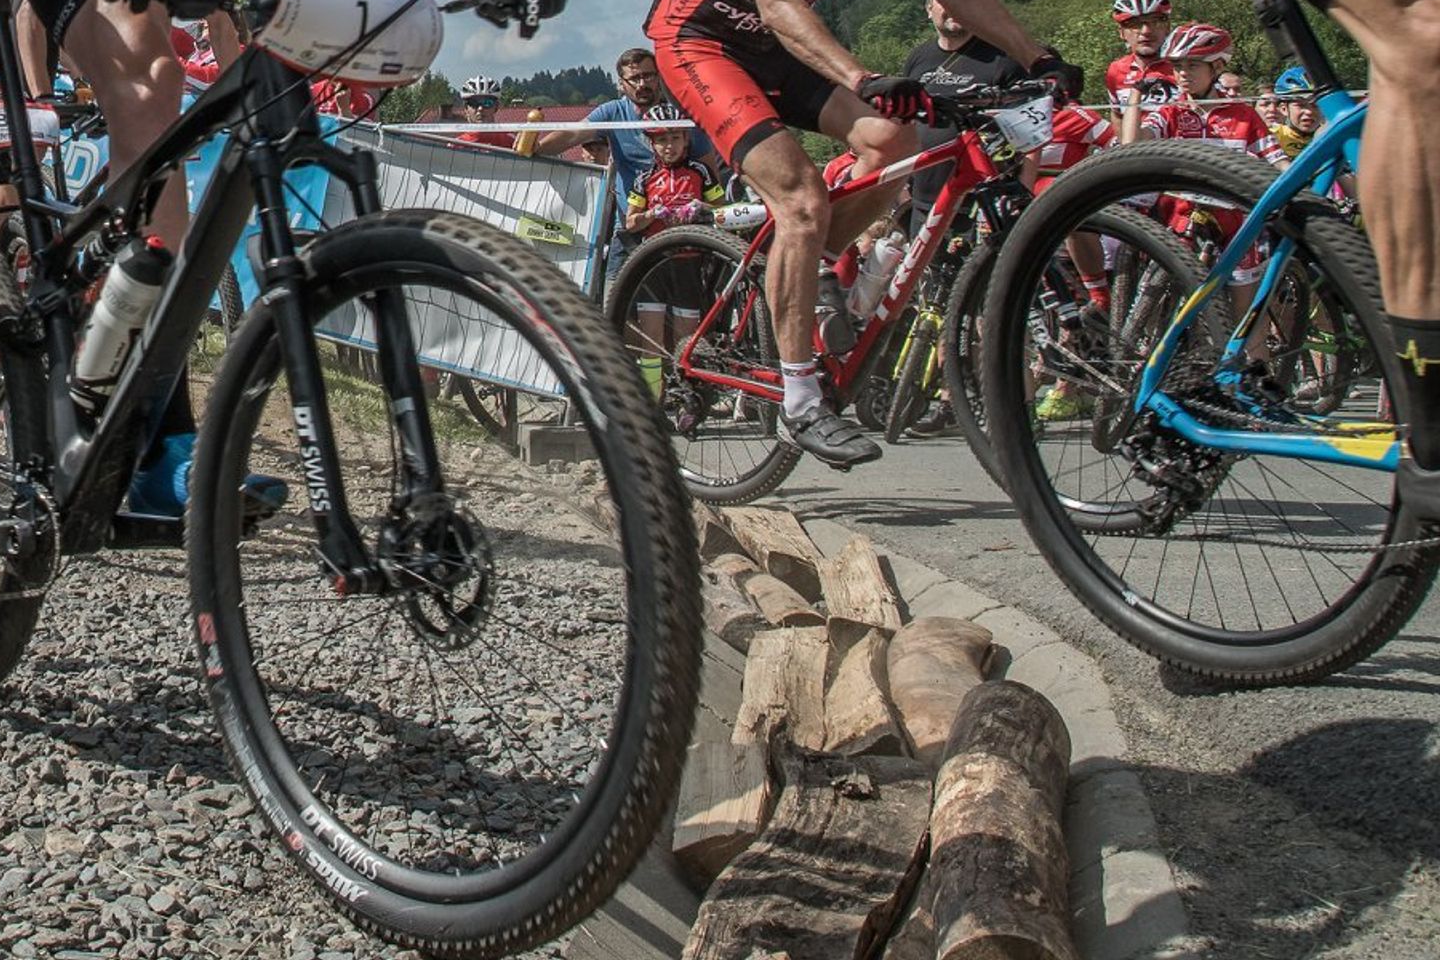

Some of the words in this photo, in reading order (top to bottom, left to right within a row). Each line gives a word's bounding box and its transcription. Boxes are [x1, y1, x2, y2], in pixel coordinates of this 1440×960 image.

[1020, 106, 1046, 125] 35
[875, 204, 943, 321] TREK
[293, 406, 318, 442] DT
[300, 445, 332, 512] SWISS
[299, 803, 332, 837] DT
[326, 834, 384, 883] SWISS
